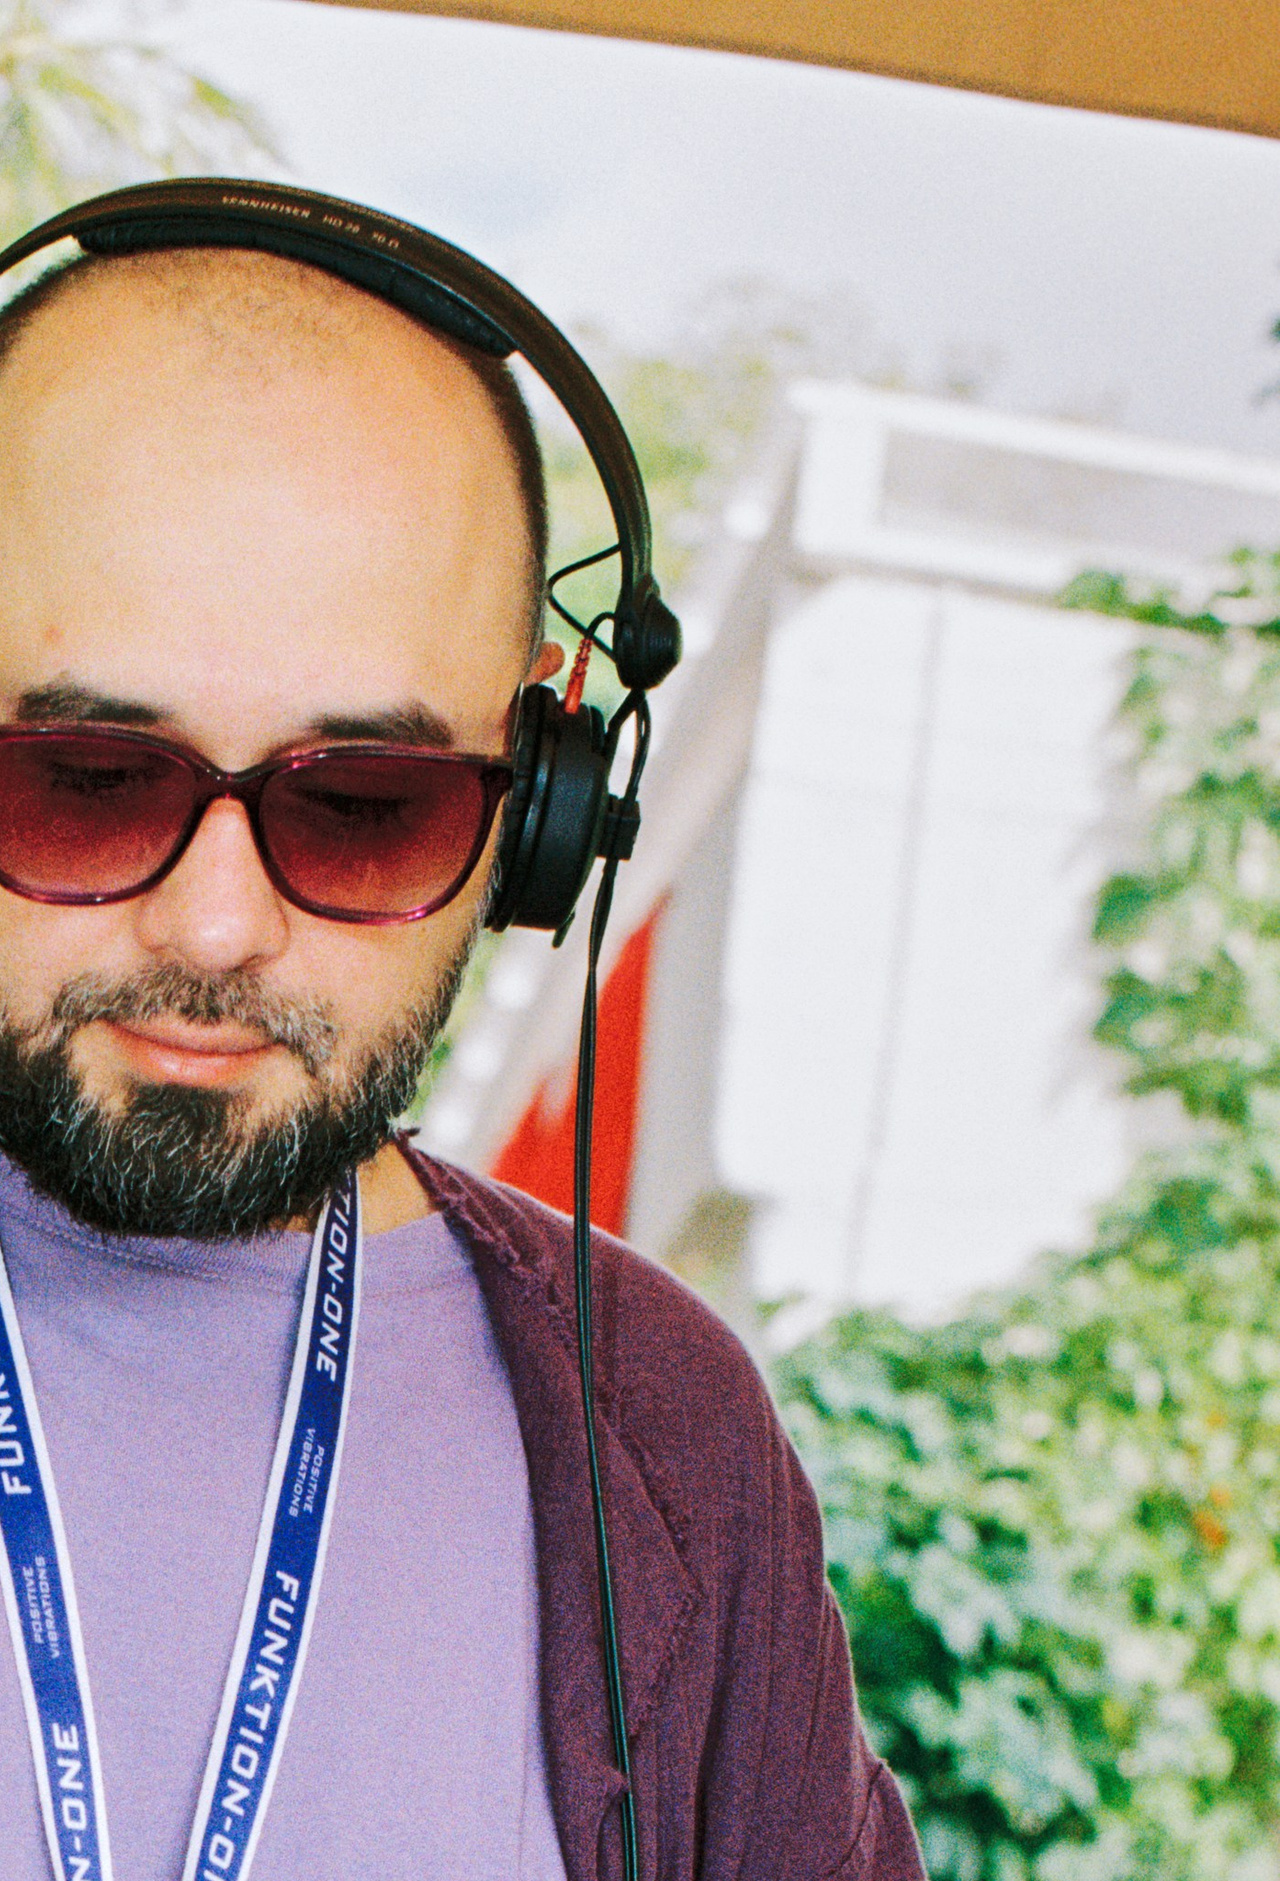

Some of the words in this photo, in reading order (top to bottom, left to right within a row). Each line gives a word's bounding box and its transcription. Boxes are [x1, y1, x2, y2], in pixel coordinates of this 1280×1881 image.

[288, 1427, 317, 1518] VIBRATIONS
[303, 1444, 325, 1515] POSITIVE
[22, 1565, 45, 1645] POSITIVE
[34, 1555, 61, 1659] VIBRATIONS
